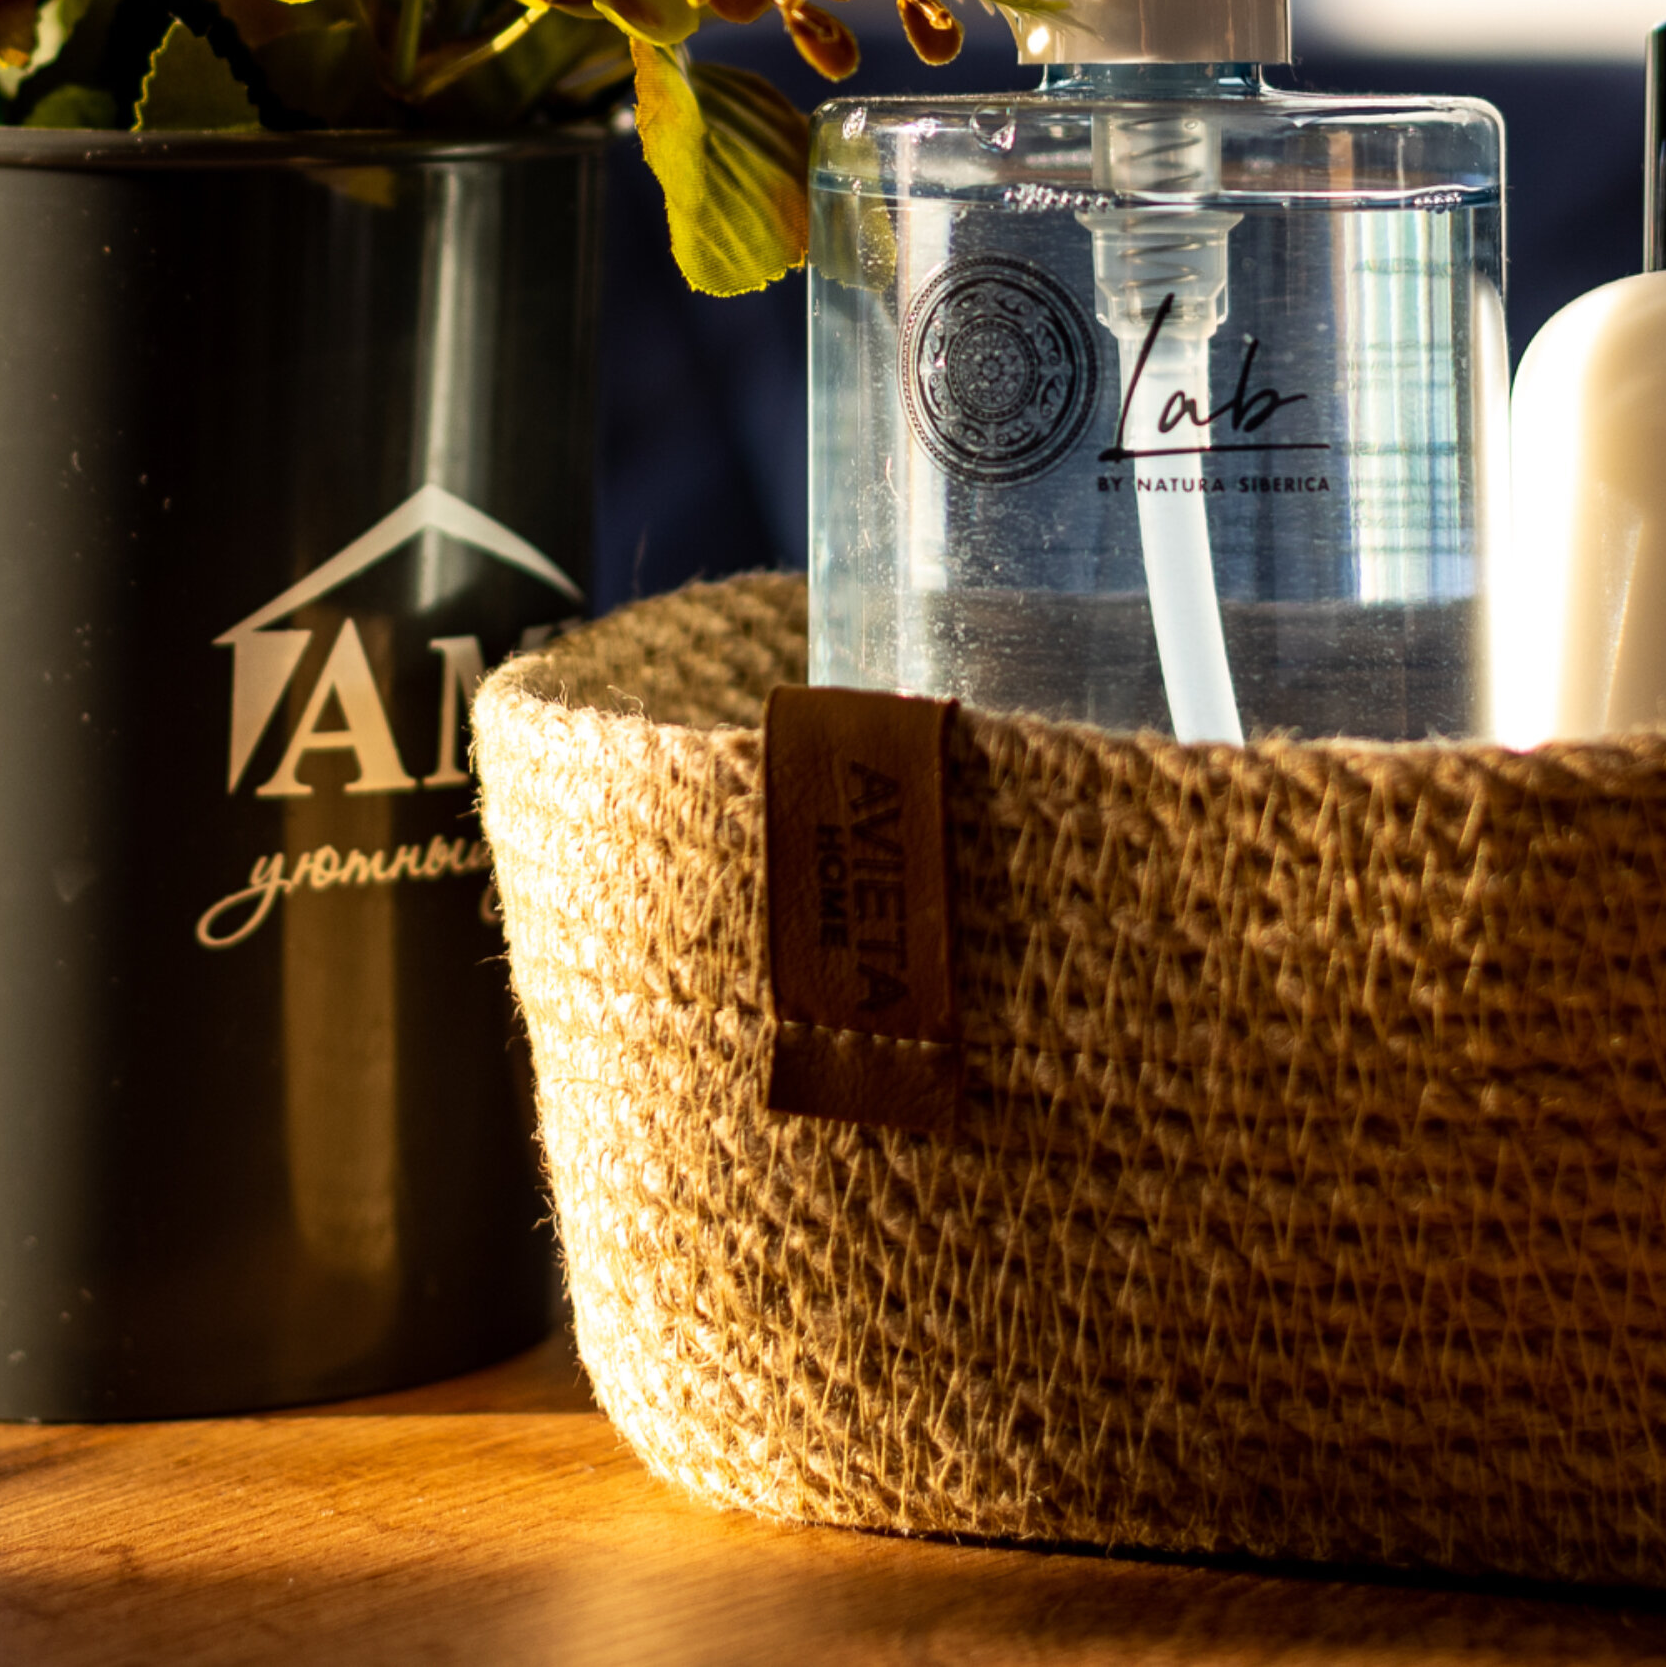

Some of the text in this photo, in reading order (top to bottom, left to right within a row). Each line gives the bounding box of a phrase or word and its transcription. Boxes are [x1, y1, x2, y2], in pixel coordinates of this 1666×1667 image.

[1097, 292, 1331, 462] Lab
[1097, 476, 1331, 493] BY NATURA SIBERICA
[196, 834, 495, 949] уютны
[817, 823, 848, 948] HOME
[849, 759, 909, 1013] AVIETA
